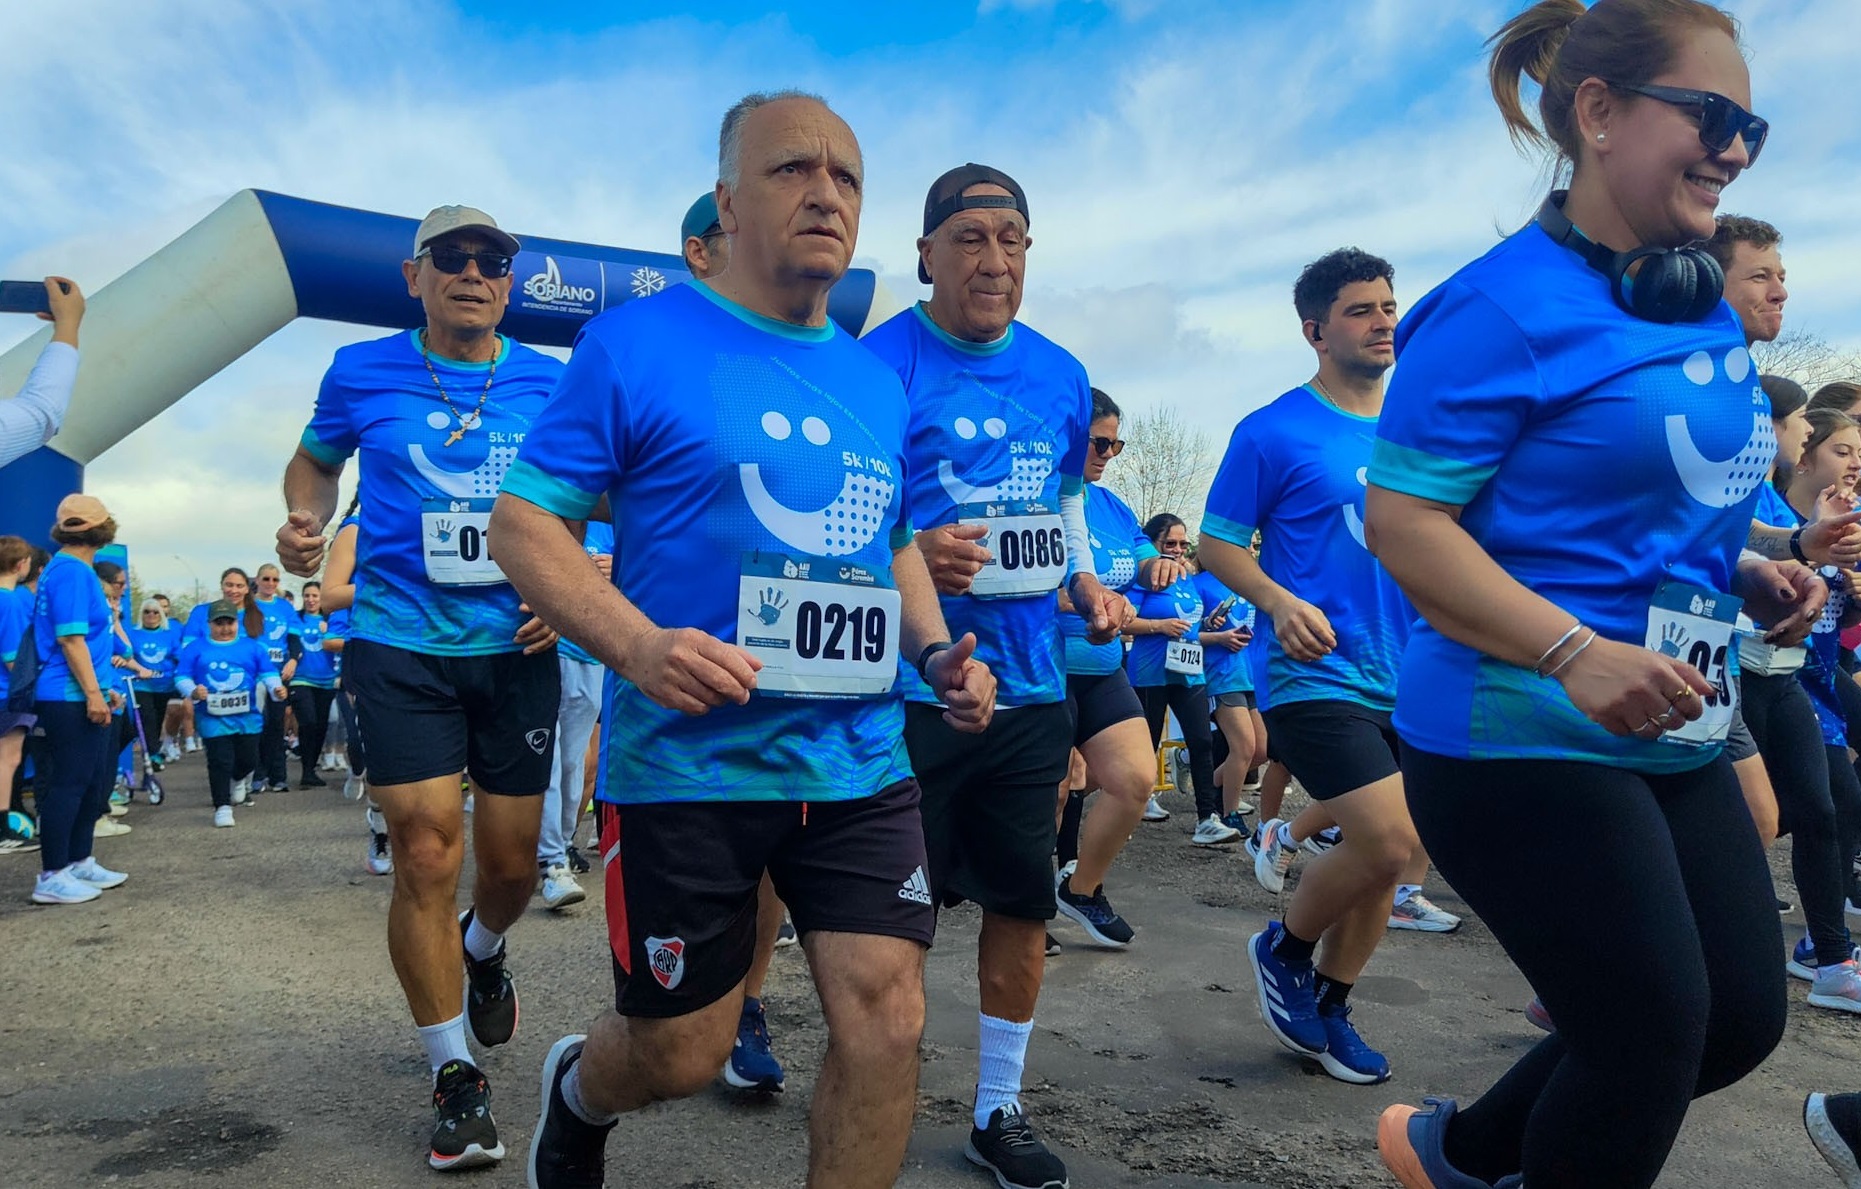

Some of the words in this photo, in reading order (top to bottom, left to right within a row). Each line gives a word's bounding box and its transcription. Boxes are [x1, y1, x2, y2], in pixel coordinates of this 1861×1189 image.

[523, 281, 596, 302] SORIANO
[568, 307, 594, 315] SORIANO
[770, 356, 801, 379] Juntos
[1000, 528, 1065, 571] 0086
[796, 601, 886, 663] 0219
[1181, 648, 1200, 666] 0124
[898, 889, 931, 905] adidas
[1000, 1103, 1015, 1118] M
